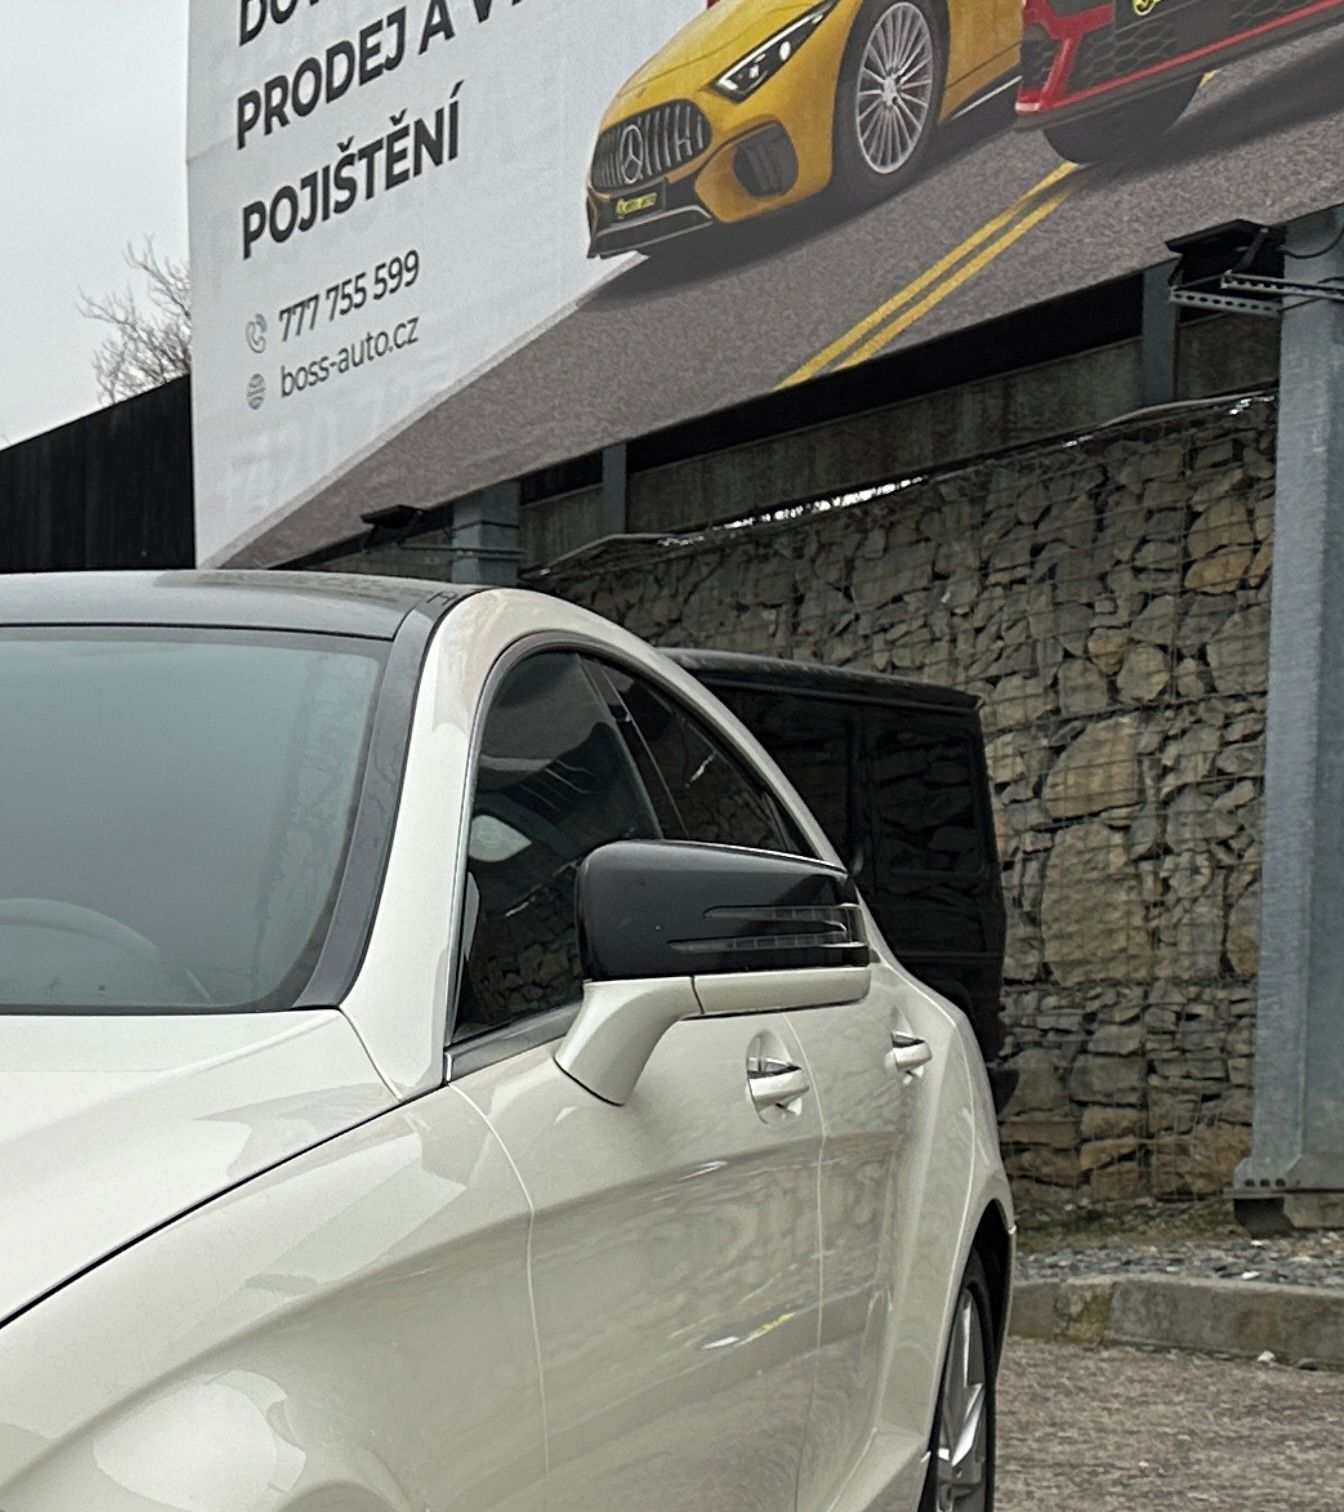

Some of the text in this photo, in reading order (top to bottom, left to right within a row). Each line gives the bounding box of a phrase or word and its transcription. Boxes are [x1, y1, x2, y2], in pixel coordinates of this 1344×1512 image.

[237, 6, 407, 150] PRODEJ
[417, 0, 455, 55] A
[242, 79, 464, 260] POJIŠTĚNÍ
[279, 249, 420, 342] 777 755 599
[281, 317, 420, 398] boss-auto.cz
